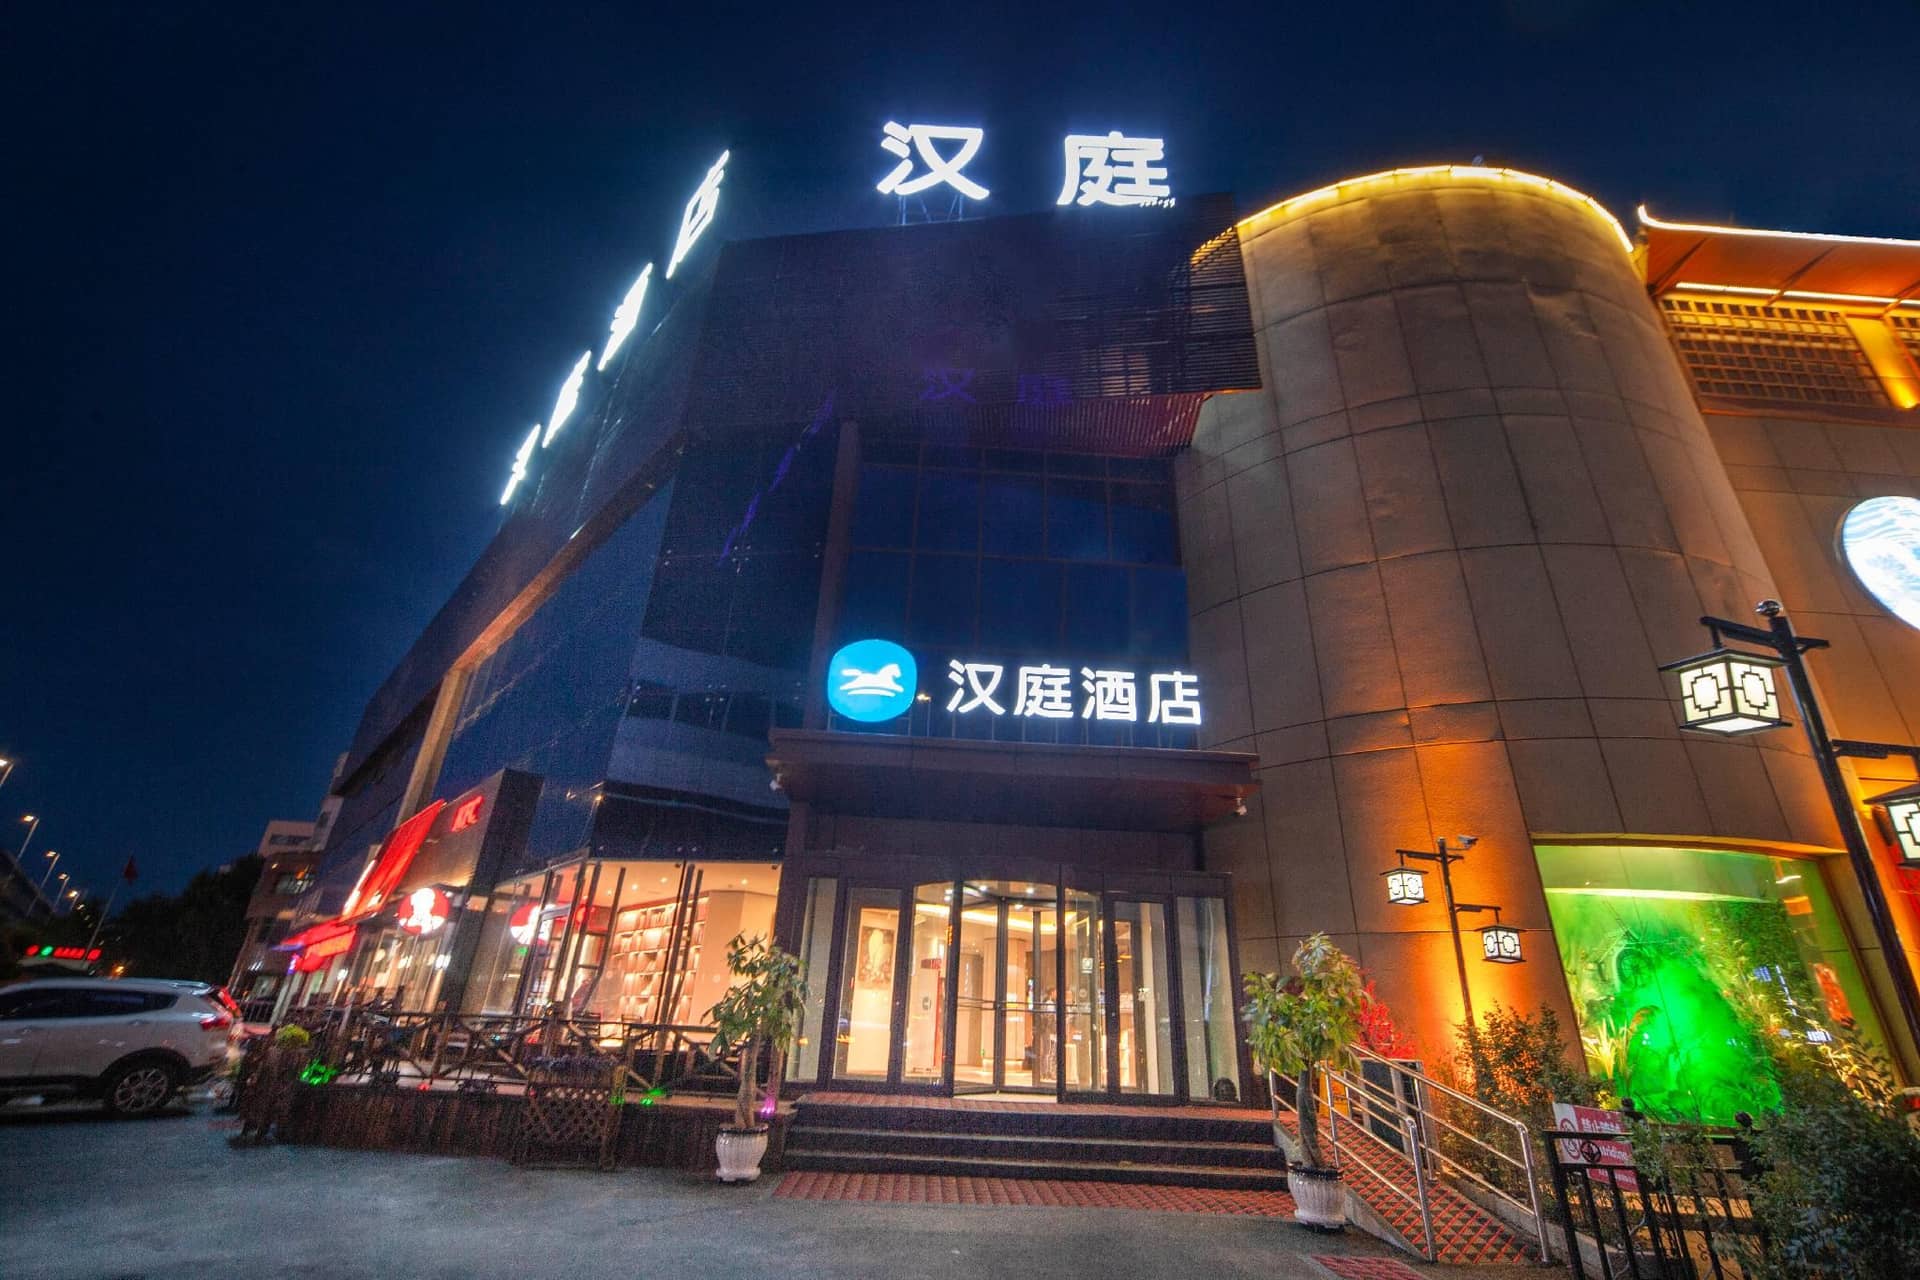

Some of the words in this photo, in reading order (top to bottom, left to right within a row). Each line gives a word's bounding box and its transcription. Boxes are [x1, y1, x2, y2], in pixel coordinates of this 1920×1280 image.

[876, 120, 1176, 208] 汉庭
[946, 659, 1202, 725] 汉庭酒店
